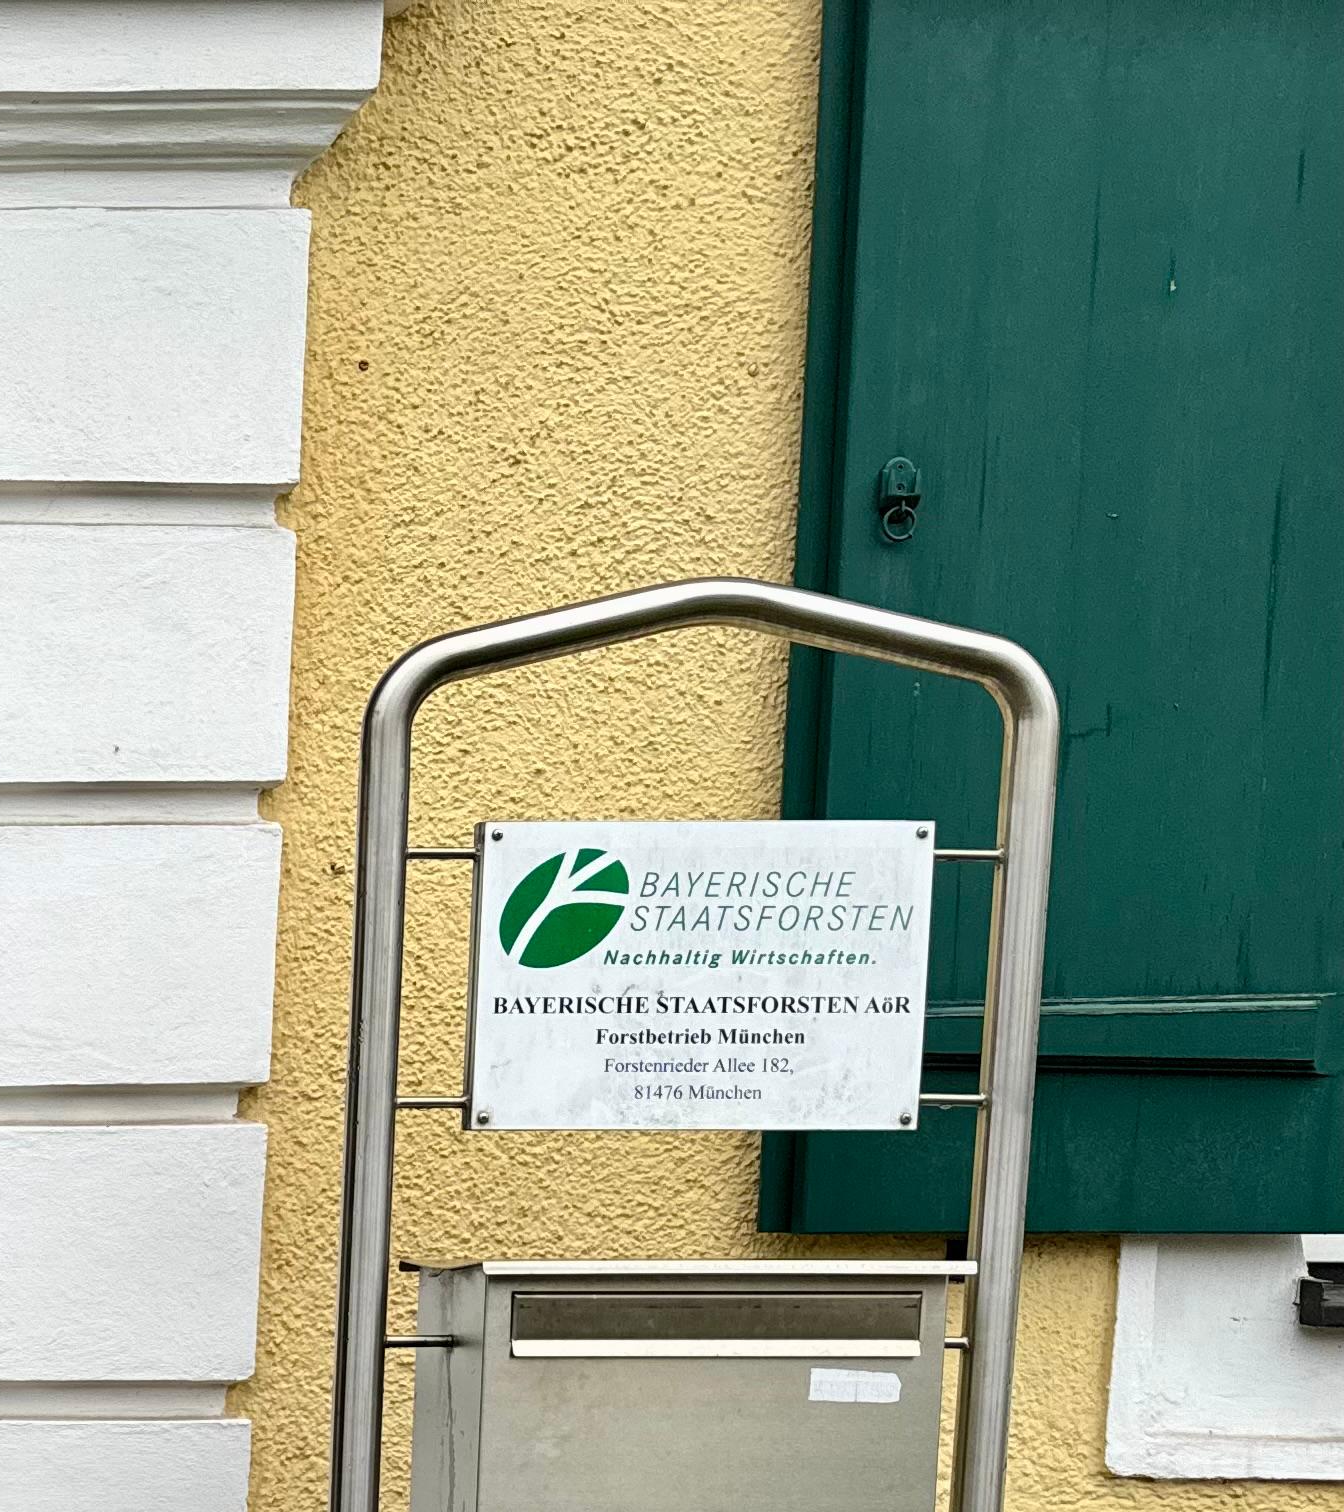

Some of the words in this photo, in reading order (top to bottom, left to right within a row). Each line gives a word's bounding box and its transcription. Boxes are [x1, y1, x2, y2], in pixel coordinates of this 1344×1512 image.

[639, 871, 857, 898] BAYERISCHE
[630, 905, 914, 932] STAATSFORSTEN
[603, 950, 722, 968] Nachhaltig
[731, 950, 877, 965] Wirtschaften.
[493, 996, 650, 1014] BAYERISCHE
[656, 996, 860, 1014] STAATSFORSTEN
[864, 996, 911, 1014] AöR
[596, 1028, 712, 1045] Forstbetrieb
[718, 1028, 805, 1045] München
[604, 1058, 709, 1073] Forstenrieder
[713, 1058, 755, 1073] Allee
[762, 1058, 794, 1075] 182,
[634, 1085, 683, 1100] 81476
[689, 1085, 762, 1100] München
